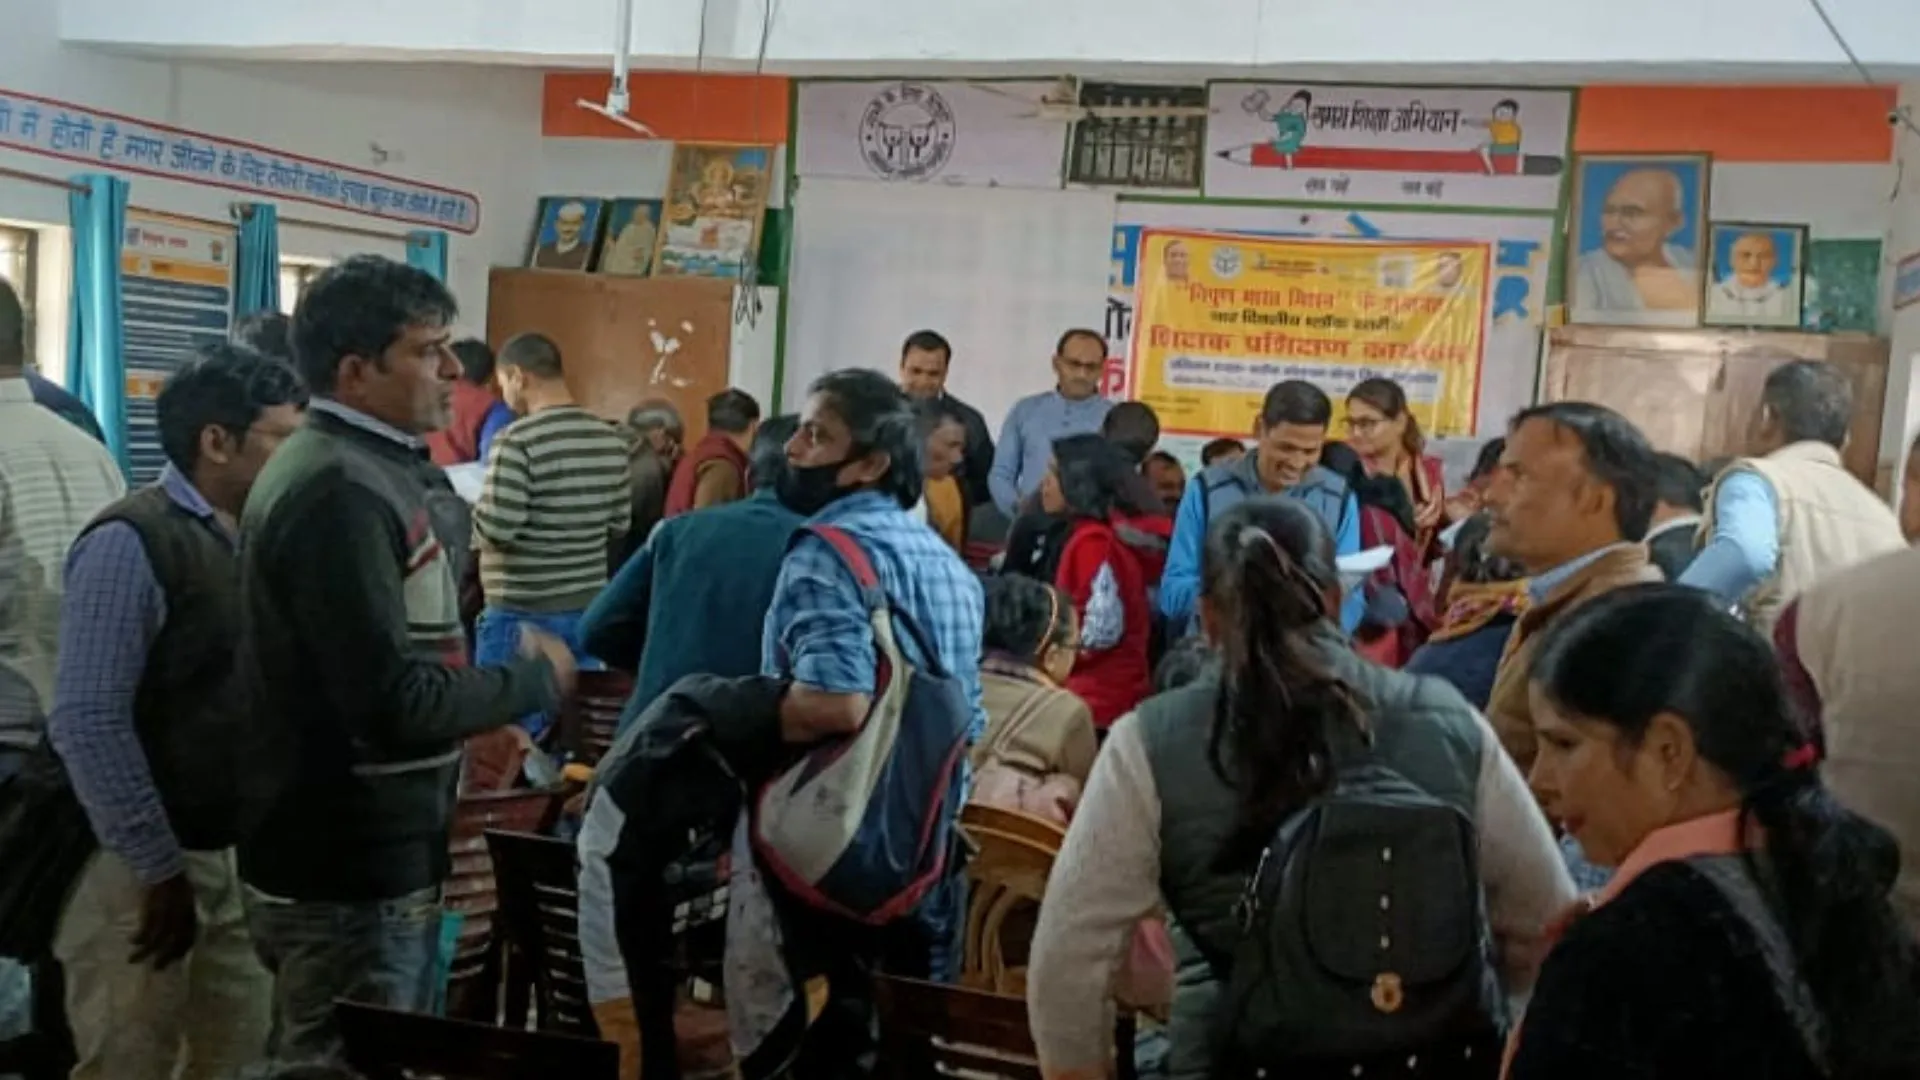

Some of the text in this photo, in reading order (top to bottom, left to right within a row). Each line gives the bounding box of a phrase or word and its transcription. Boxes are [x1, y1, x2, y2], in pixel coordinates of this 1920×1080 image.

[50, 111, 96, 151] होती
[1391, 99, 1461, 133] अभियान
[1150, 324, 1241, 350] शिक्षक
